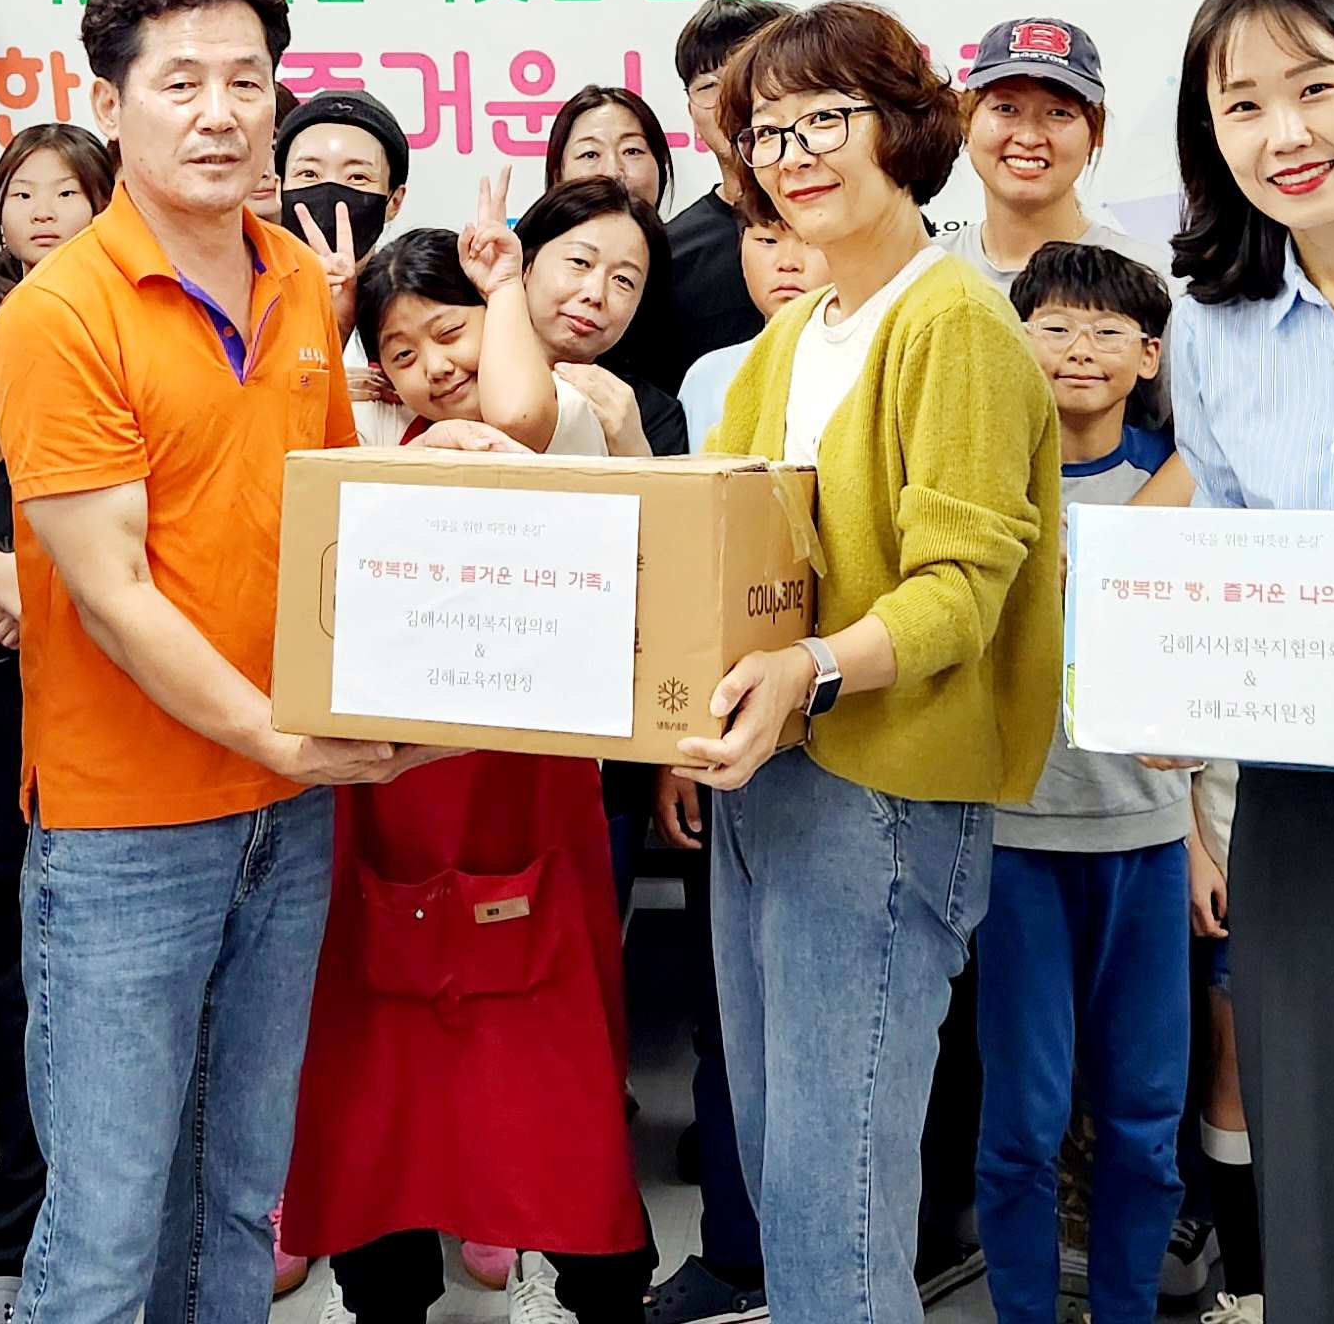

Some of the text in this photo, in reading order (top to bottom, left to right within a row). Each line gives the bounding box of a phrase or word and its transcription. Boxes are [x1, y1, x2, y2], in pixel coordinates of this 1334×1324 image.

[1009, 22, 1072, 58] B
[1009, 51, 1069, 67] BOSTON
[359, 558, 419, 580] 『행복한
[460, 564, 513, 586] 즐거운
[523, 568, 557, 588] 나의
[567, 571, 612, 593] 가족』
[747, 579, 805, 625] coupang
[1102, 578, 1173, 601] 『행복한
[1223, 582, 1286, 604] 즐거운
[474, 642, 486, 659] &
[1243, 670, 1257, 687] &
